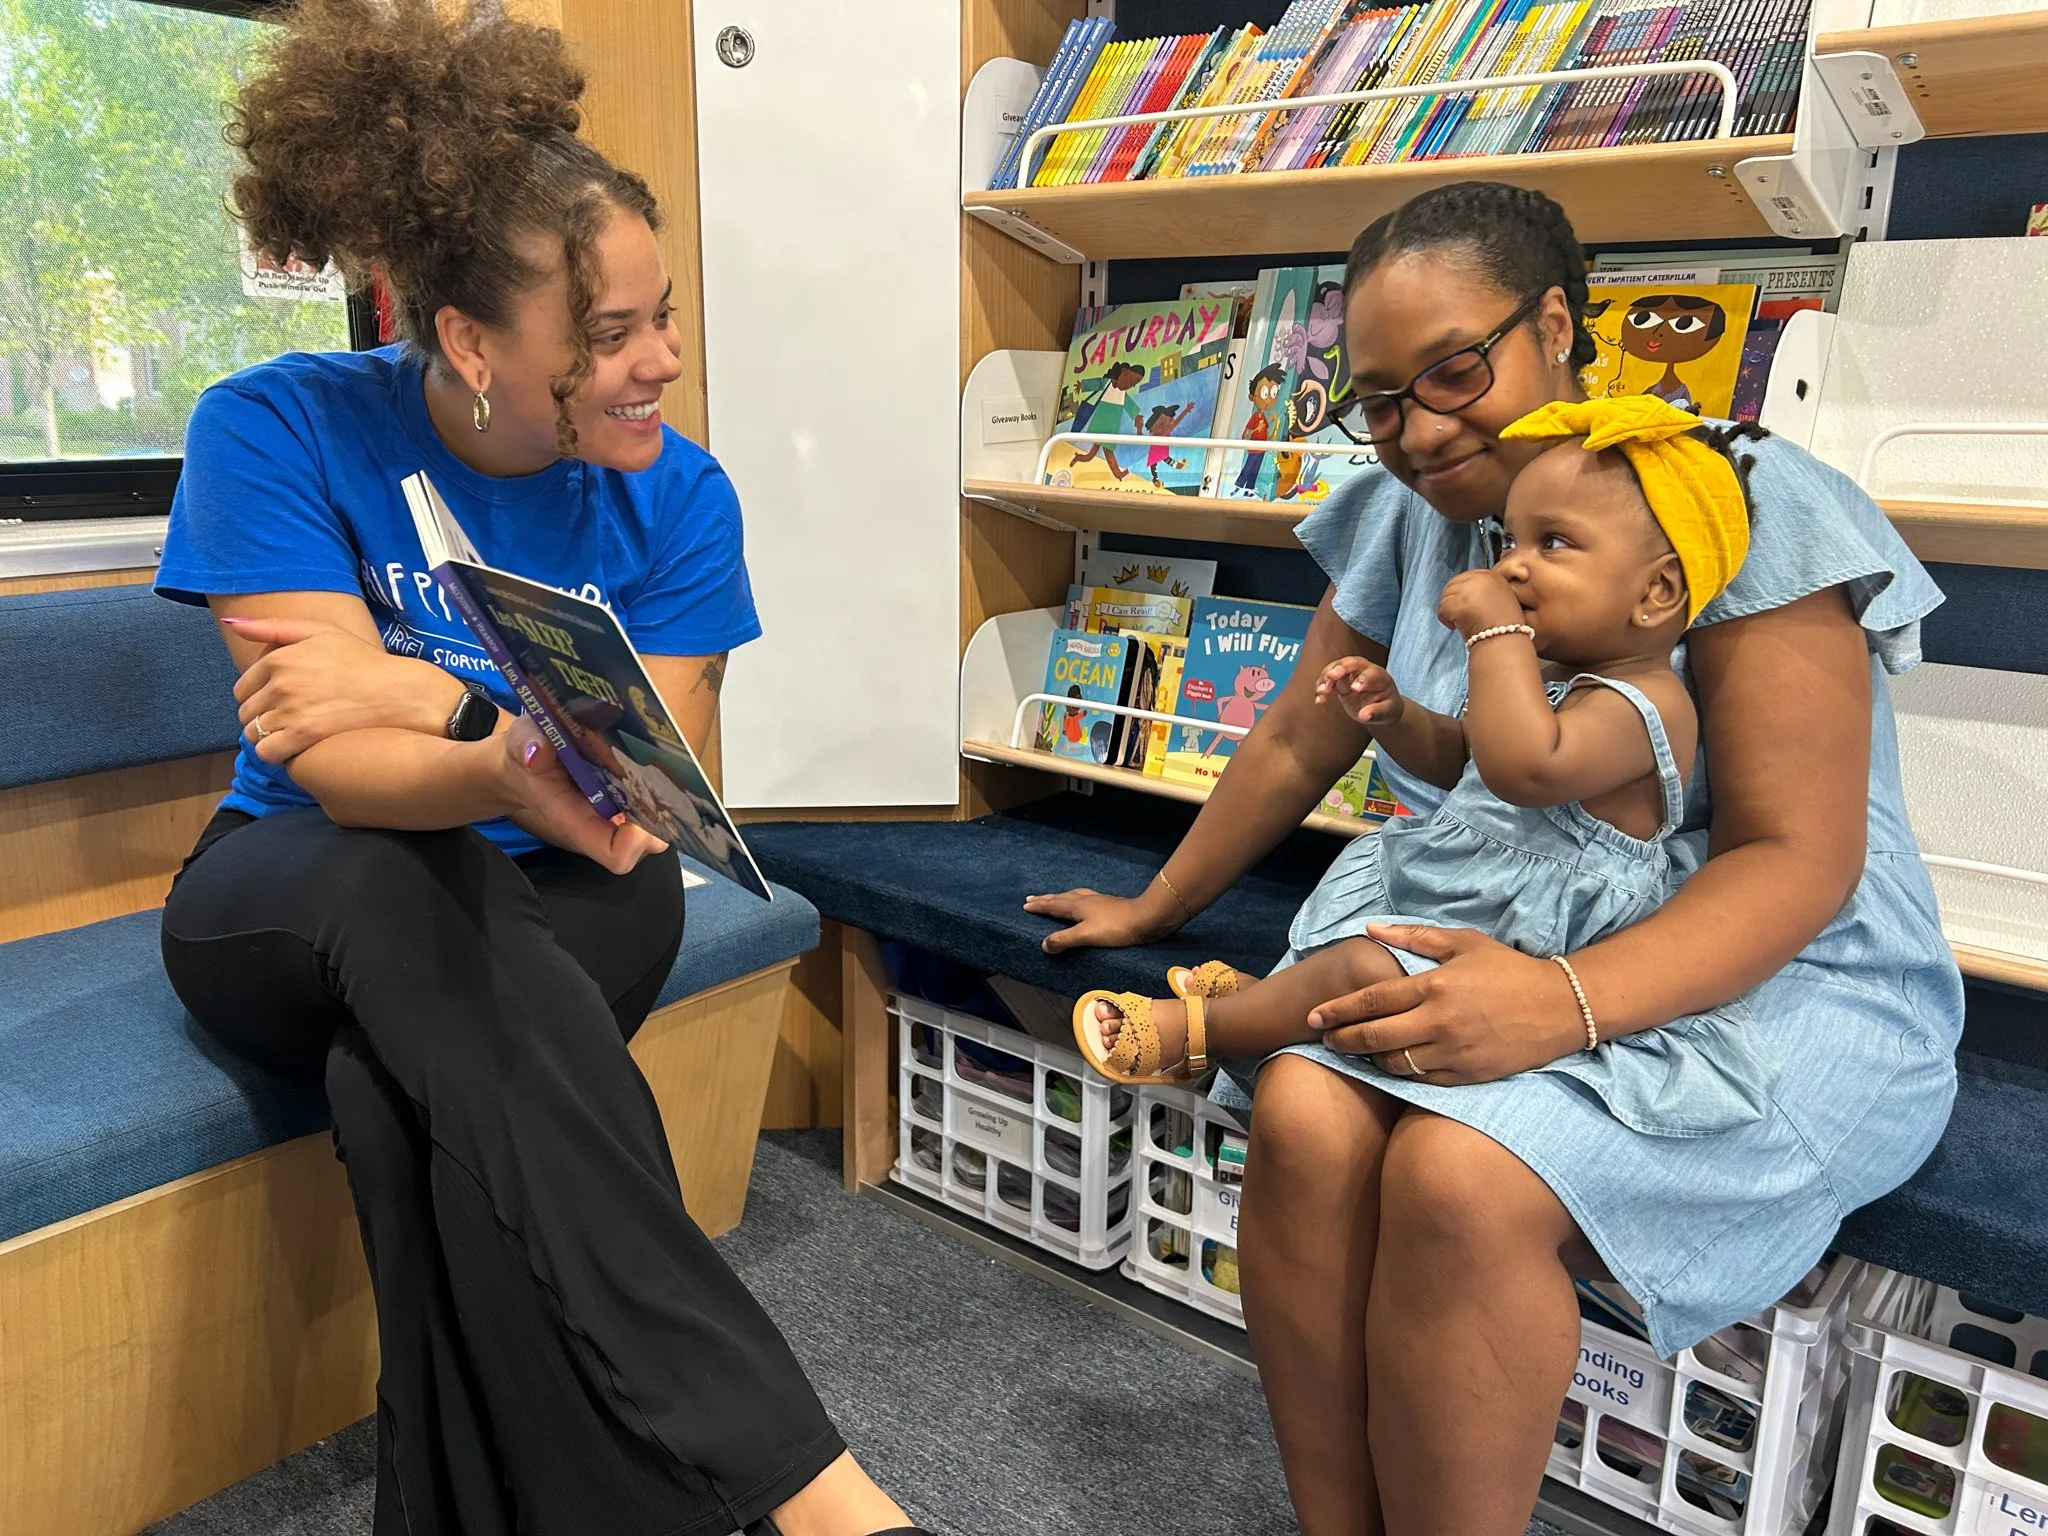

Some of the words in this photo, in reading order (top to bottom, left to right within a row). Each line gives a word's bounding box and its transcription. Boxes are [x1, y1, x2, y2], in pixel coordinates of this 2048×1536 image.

[313, 285, 327, 293] Out
[1587, 275, 1606, 285] VERY
[1608, 274, 1646, 283] IMPATIENT
[1647, 273, 1696, 282] CATERPILLAR
[1766, 269, 1836, 290] PRESENTS
[1074, 303, 1221, 374] SATURDAY
[991, 415, 1019, 426] Giveaway
[1020, 413, 1037, 423] Books
[1112, 606, 1128, 615] Can
[1130, 606, 1153, 615] Read!
[1205, 611, 1269, 633] Today
[1203, 637, 1212, 656] I
[1217, 632, 1253, 653] Will
[1263, 635, 1300, 662] Fly!
[433, 648, 500, 672] STORYM
[1054, 657, 1118, 689] OCEAN
[516, 685, 545, 714] SLEEP
[540, 717, 569, 751] TIGHT!
[1195, 767, 1208, 776] Mo
[968, 1107, 999, 1125] Growing
[998, 1116, 1009, 1128] Up
[975, 1121, 1002, 1138] Healthy
[1579, 1347, 1644, 1388] nding
[1573, 1371, 1629, 1406] ooks
